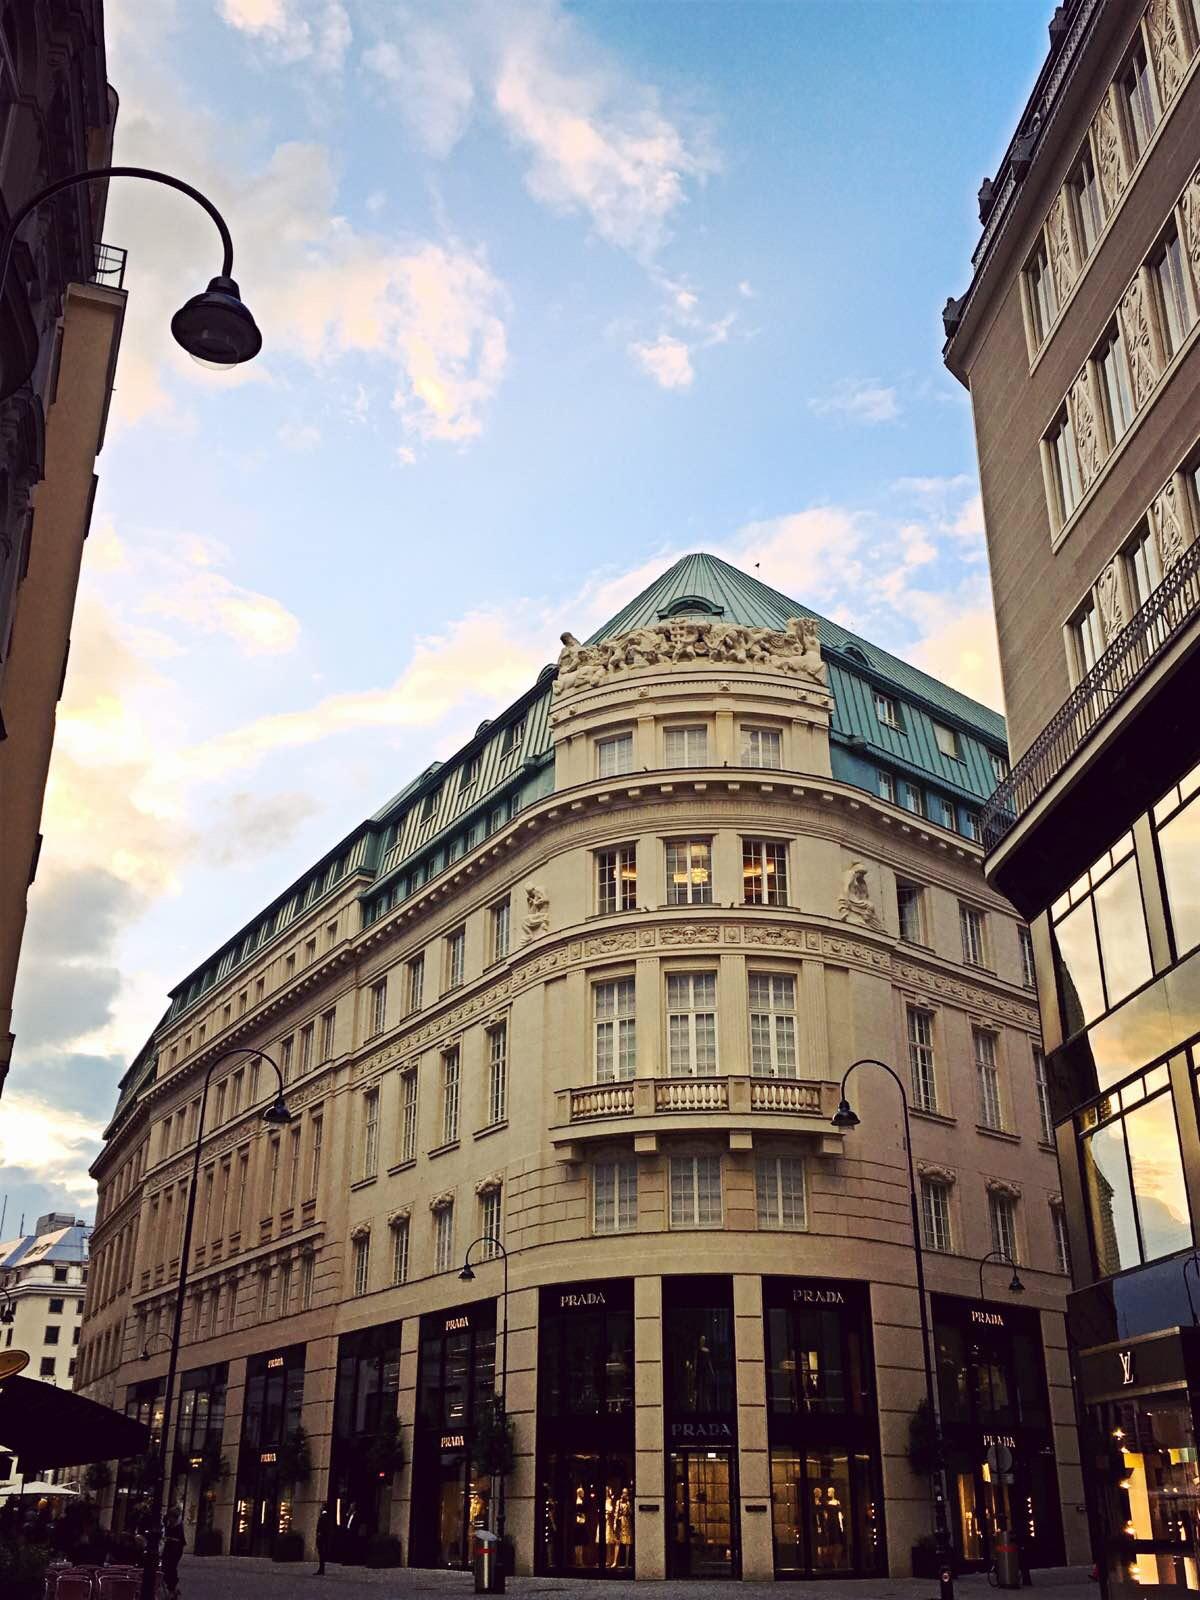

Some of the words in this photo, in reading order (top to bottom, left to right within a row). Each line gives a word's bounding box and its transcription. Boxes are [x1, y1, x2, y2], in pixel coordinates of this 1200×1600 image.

[561, 1292, 606, 1308] PRADA
[792, 1289, 845, 1304] PRADA
[445, 1316, 469, 1331] PRADA
[971, 1310, 1005, 1327] PRADA
[671, 1423, 732, 1436] PRADA
[441, 1435, 465, 1448] PRADA
